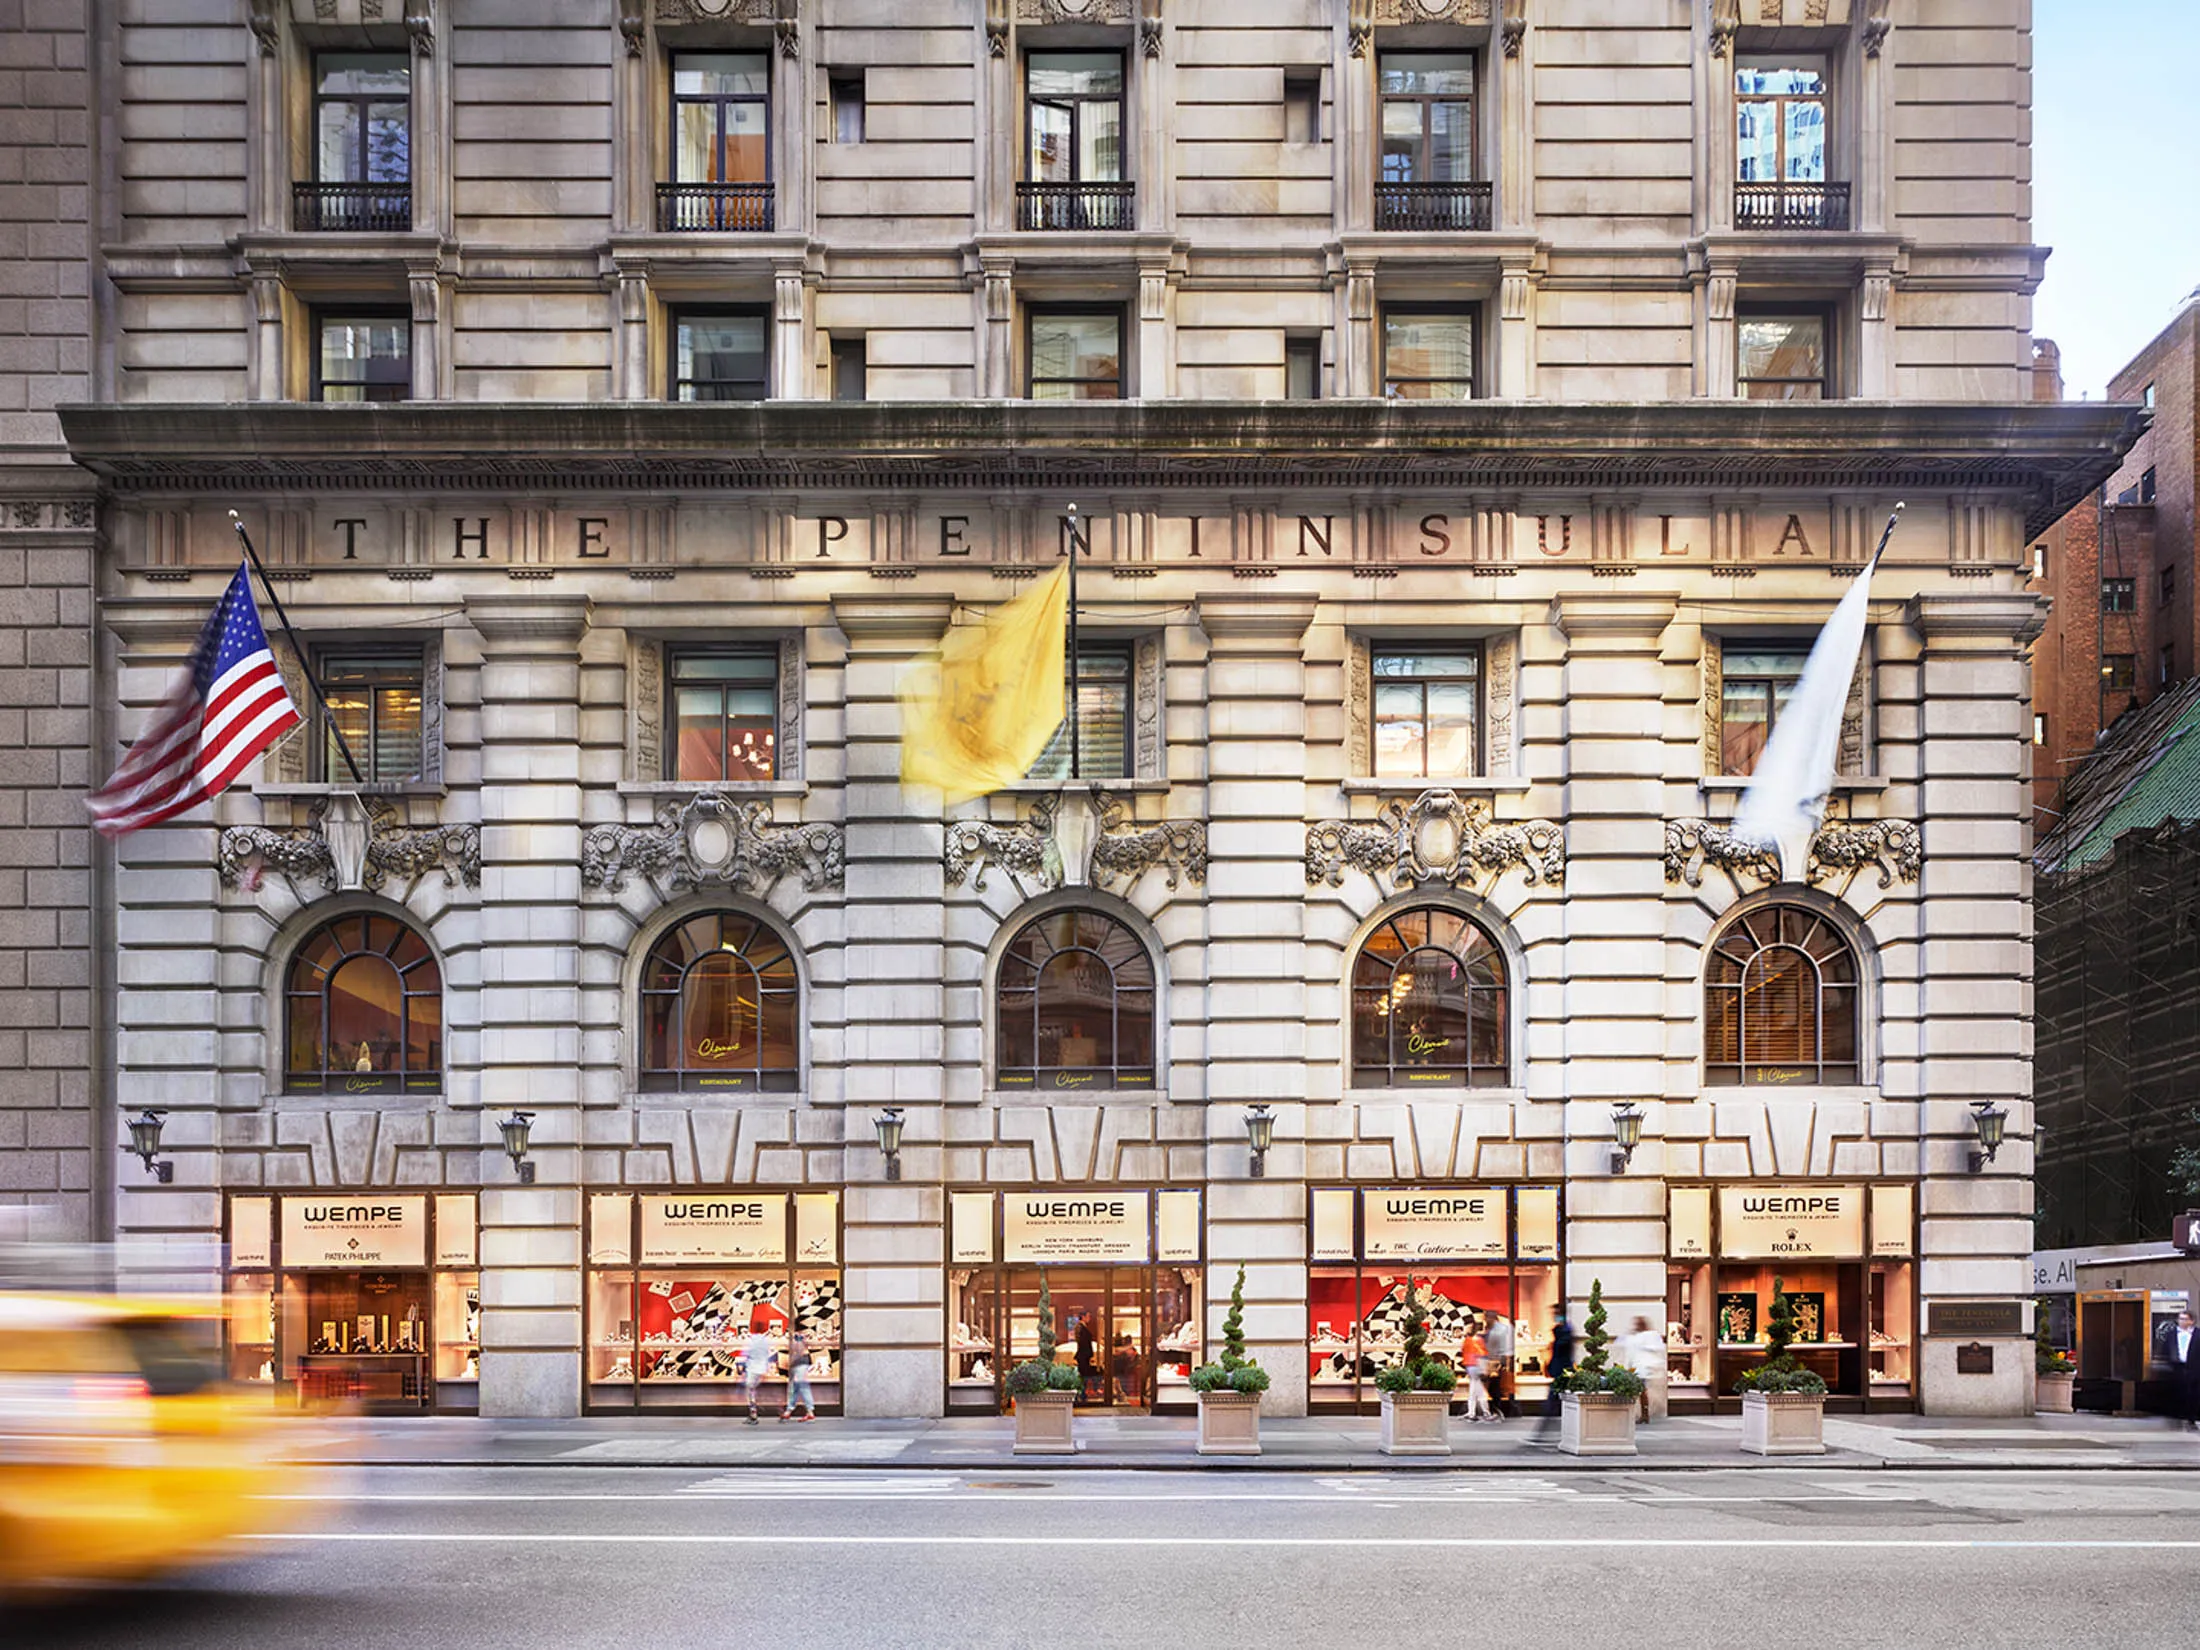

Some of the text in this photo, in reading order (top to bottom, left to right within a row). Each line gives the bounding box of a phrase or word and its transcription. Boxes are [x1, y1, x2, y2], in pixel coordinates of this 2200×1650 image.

[334, 513, 1814, 559] THE PENINSULA
[664, 1203, 762, 1218] WEMPE
[1026, 1202, 1124, 1217] WEMPE
[1387, 1200, 1484, 1215] WEMPE
[1743, 1198, 1840, 1212] WEMPE
[304, 1206, 402, 1222] WEMPE
[1417, 1241, 1454, 1254] Cartier
[1771, 1243, 1812, 1252] ROLEX
[324, 1252, 381, 1261] PATEK PHILIPPE
